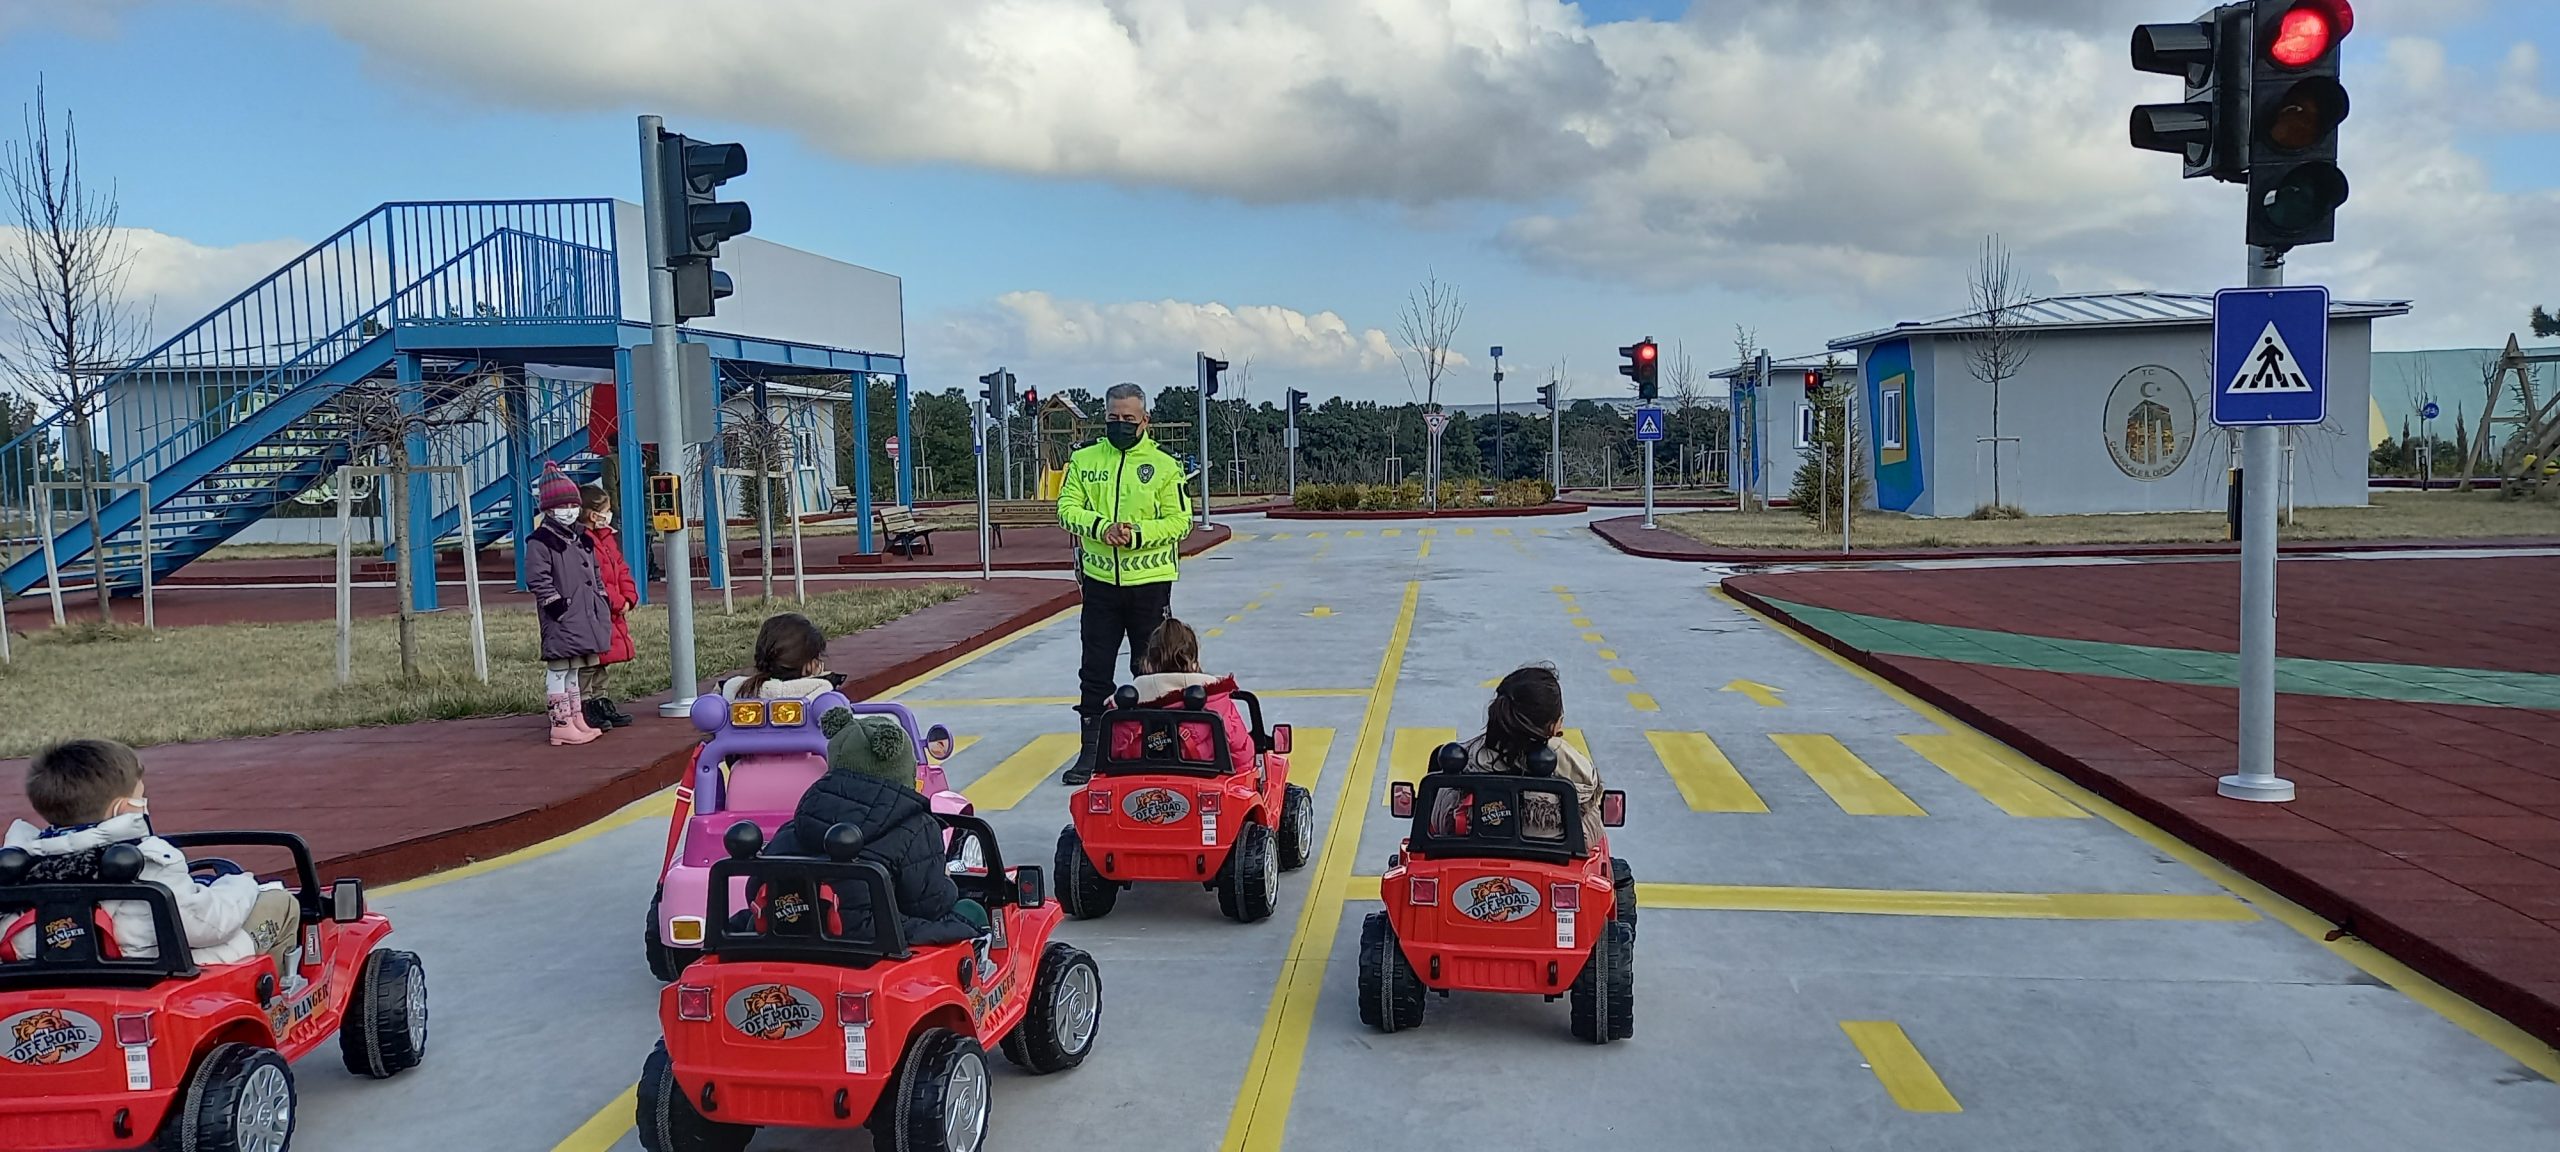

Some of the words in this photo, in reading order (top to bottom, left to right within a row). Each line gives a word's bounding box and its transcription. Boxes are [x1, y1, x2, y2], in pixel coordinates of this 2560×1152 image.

[1481, 809, 1512, 823] RANGER
[775, 904, 810, 919] RANGER
[46, 927, 85, 946] RANGER
[988, 971, 1016, 1010] RANGER
[294, 984, 329, 1021] RANGER
